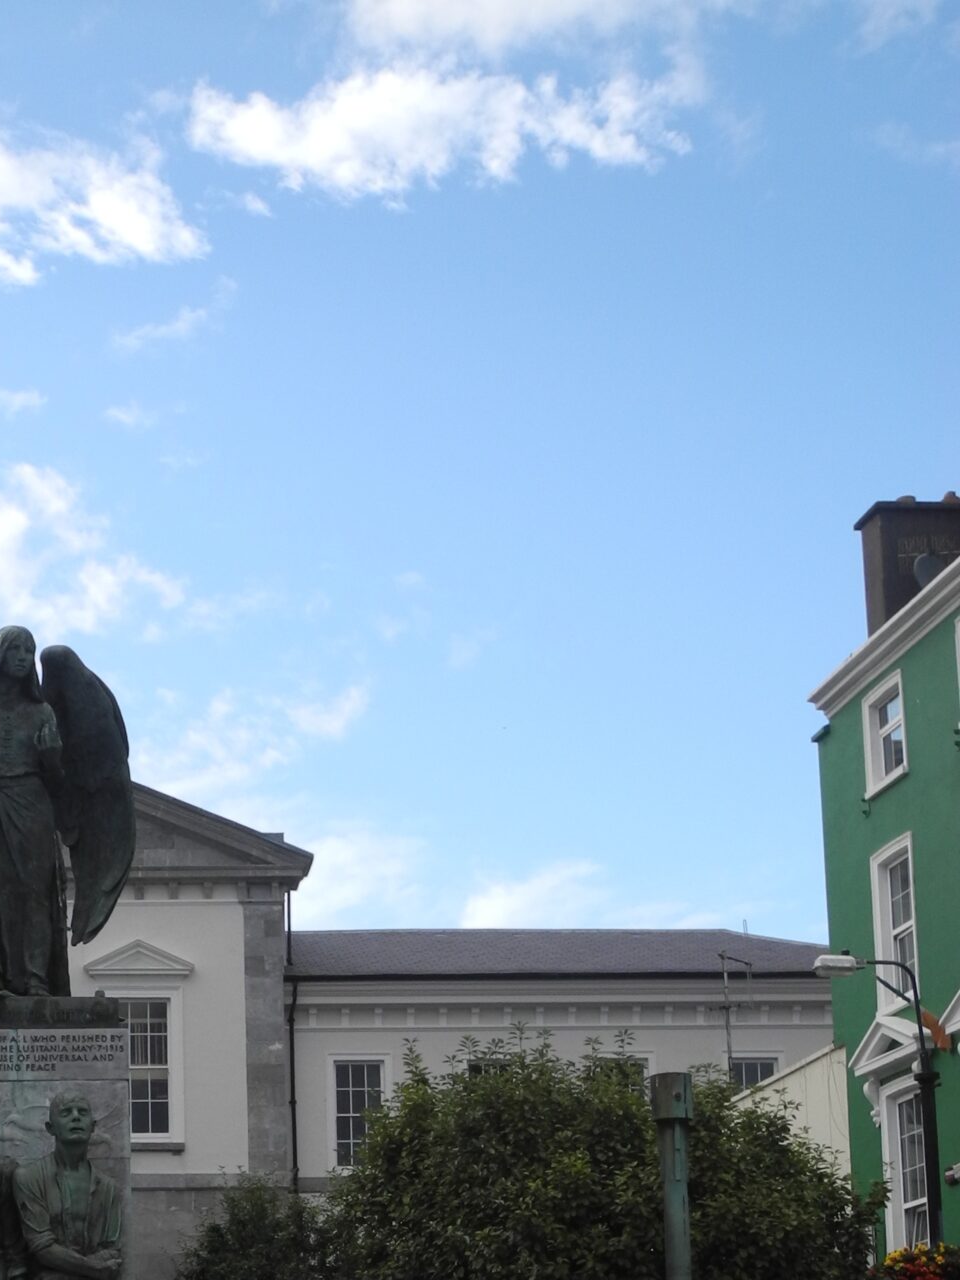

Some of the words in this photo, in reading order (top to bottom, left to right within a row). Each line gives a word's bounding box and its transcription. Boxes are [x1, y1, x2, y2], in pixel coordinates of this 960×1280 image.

[9, 1035, 27, 1043] AL
[30, 1035, 57, 1043] WHO
[61, 1035, 108, 1043] PERISHED
[110, 1035, 124, 1043] BY
[17, 1045, 69, 1053] LUSITANIA
[17, 1054, 30, 1062] OF
[33, 1054, 89, 1062] UNIVERSAL
[91, 1054, 115, 1062] AND
[25, 1064, 57, 1072] PEACE
